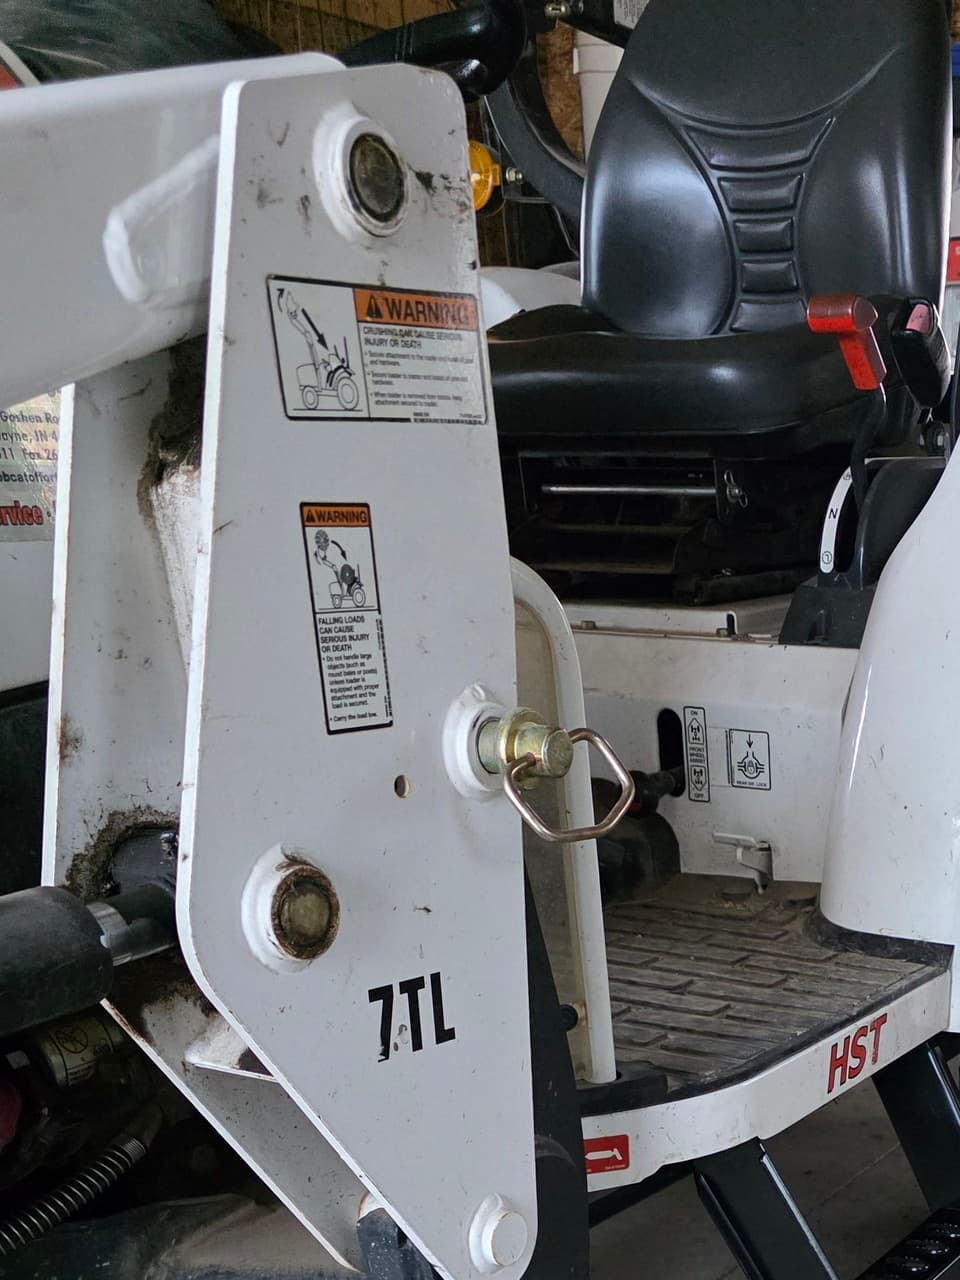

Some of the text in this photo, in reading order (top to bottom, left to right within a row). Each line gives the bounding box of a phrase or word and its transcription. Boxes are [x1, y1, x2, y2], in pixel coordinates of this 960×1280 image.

[385, 296, 469, 325] WARNING
[365, 337, 389, 347] INJURY
[401, 339, 422, 350] DEATH
[0, 411, 42, 423] Goshen
[0, 431, 32, 444] ayne,
[0, 500, 43, 526] rvice
[316, 510, 367, 524] WARNING
[829, 508, 838, 519] N
[319, 615, 365, 625] FALLING LOADS
[320, 625, 354, 634] CAN CAUSE
[320, 633, 369, 644] SERIOUS INJURY
[321, 643, 352, 653] OR DEATH
[368, 971, 456, 1062] 7TL
[827, 1012, 888, 1094] HST
